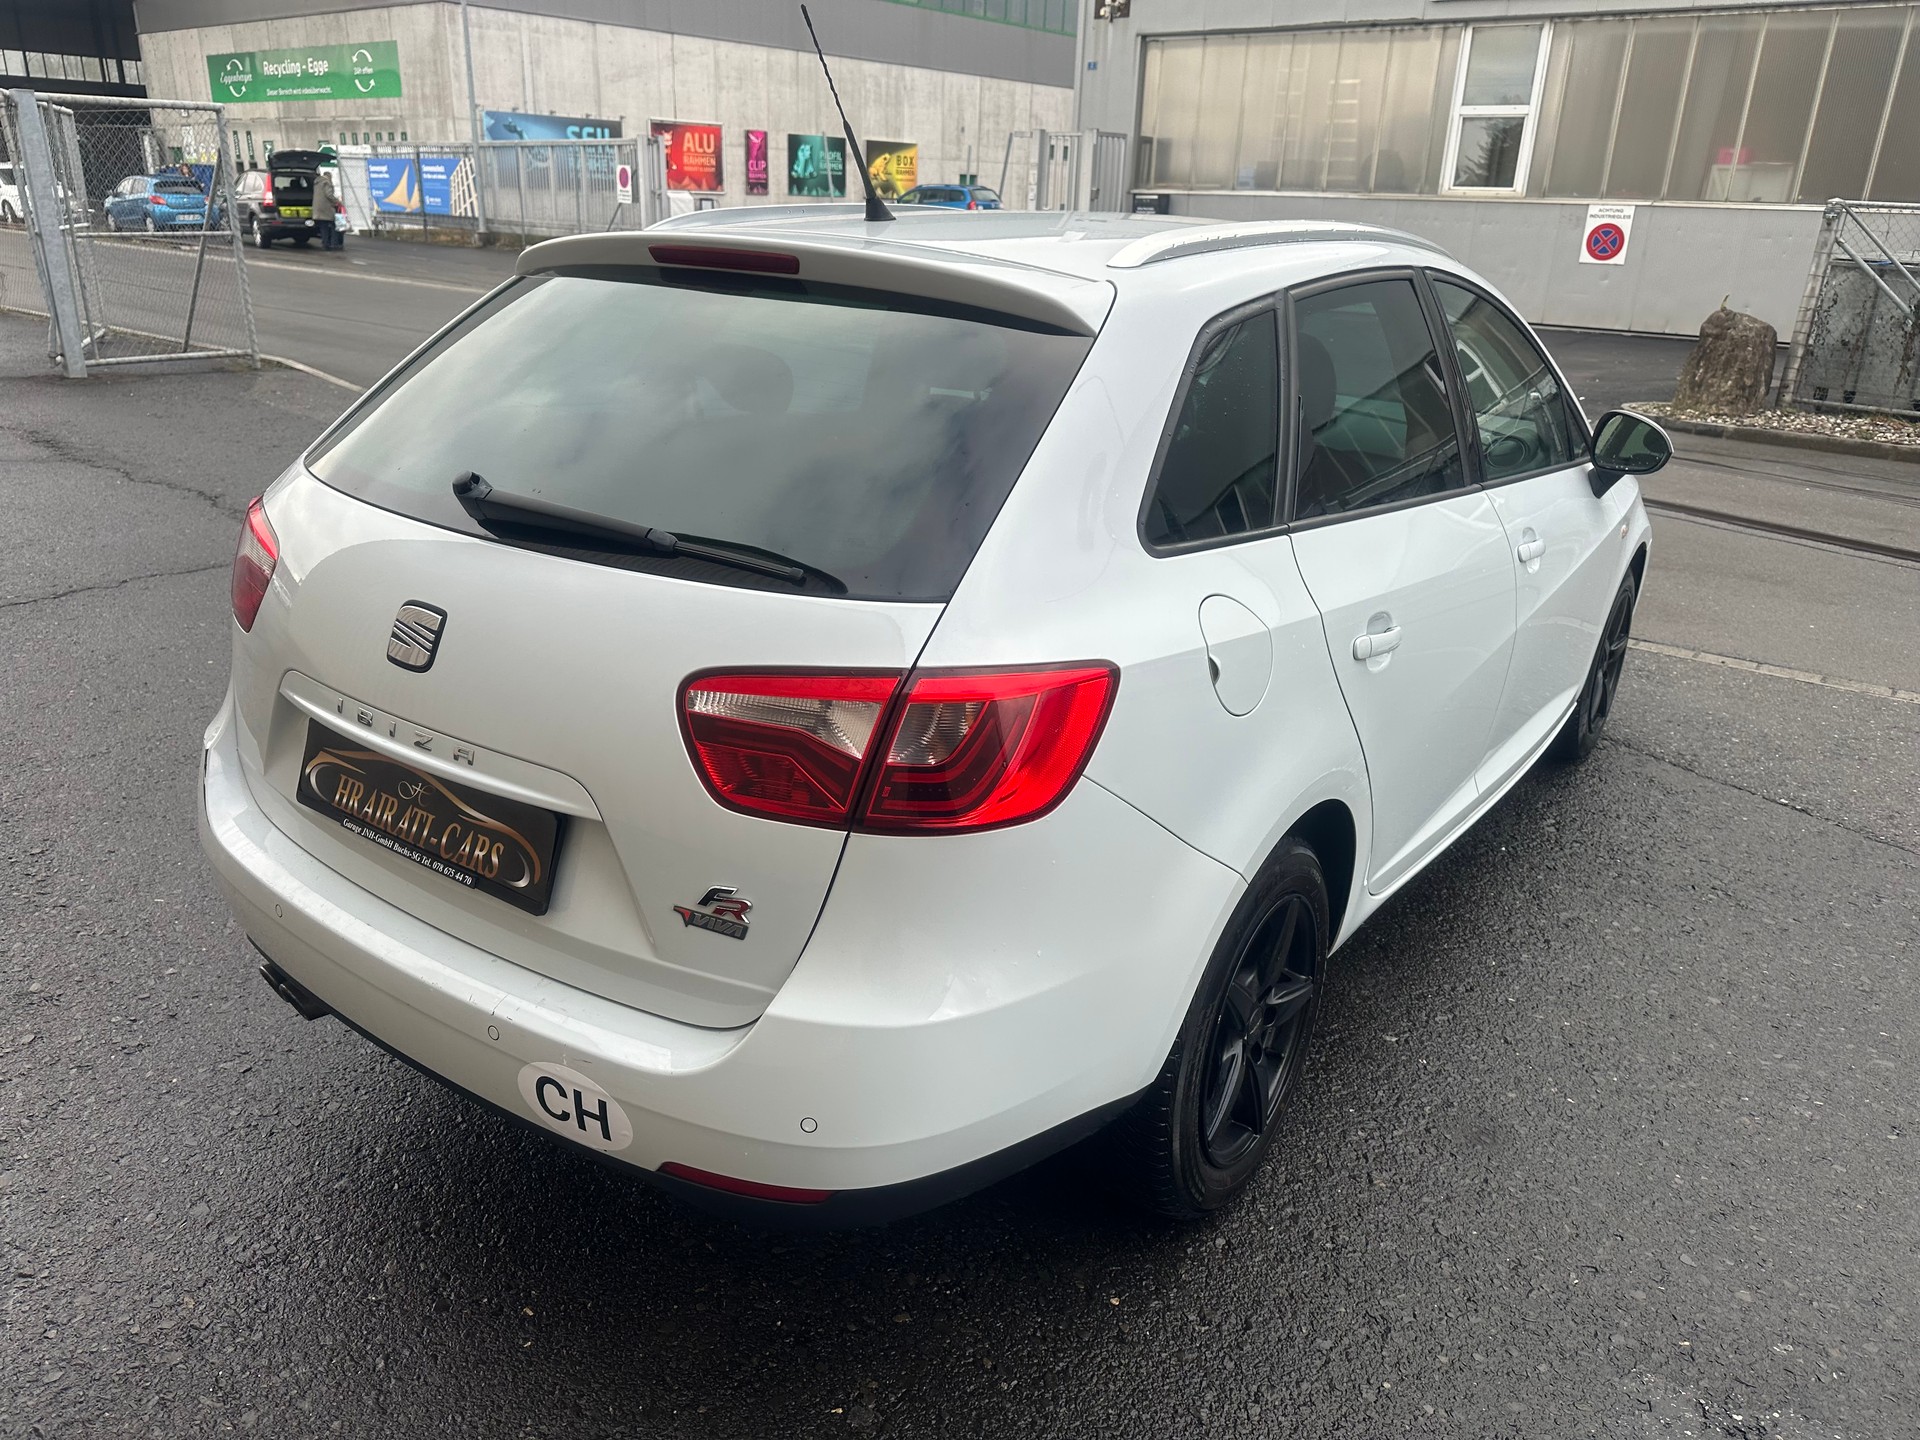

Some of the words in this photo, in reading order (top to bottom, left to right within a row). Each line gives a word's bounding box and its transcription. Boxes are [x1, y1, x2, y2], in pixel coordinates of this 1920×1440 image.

[263, 59, 301, 78] Recycling
[307, 57, 329, 76] Egge
[683, 132, 715, 153] ALU
[683, 154, 716, 166] RAHMEN
[748, 160, 767, 171] CLIP
[895, 154, 915, 167] BOX
[337, 697, 476, 767] IBIZA
[343, 818, 362, 834] Garage
[421, 855, 431, 867] Tel.
[432, 861, 445, 873] 078
[443, 866, 455, 878] 675
[455, 871, 464, 882] 44
[463, 875, 473, 885] 70
[697, 884, 752, 924] FR
[535, 1075, 612, 1142] CH
